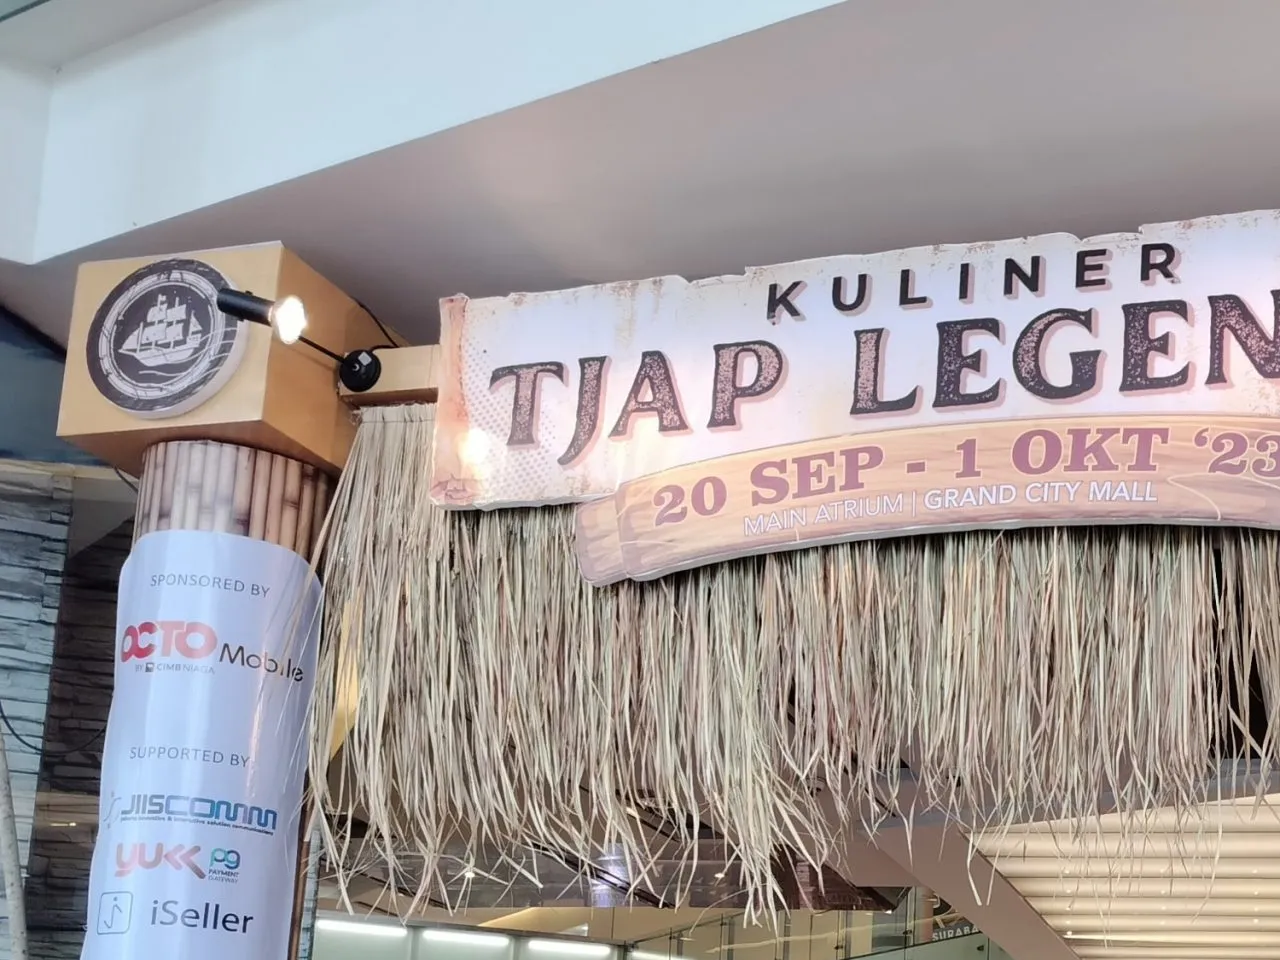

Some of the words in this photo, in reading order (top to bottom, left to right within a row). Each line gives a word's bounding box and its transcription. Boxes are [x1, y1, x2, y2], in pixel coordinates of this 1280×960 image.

[767, 243, 1179, 321] KULINER
[489, 340, 785, 466] TJAP
[653, 475, 728, 527] 20
[749, 445, 884, 507] SEP
[954, 438, 981, 479] 1
[1011, 427, 1170, 476] OKT
[743, 511, 807, 537] MAIN
[814, 493, 903, 523] ATRIUM
[923, 484, 1017, 510] GRAND
[1024, 481, 1080, 503] CITY
[1088, 480, 1158, 502] MALL
[150, 573, 245, 593] SPONSORED
[251, 584, 271, 598] BY
[121, 620, 218, 663] OCTO
[129, 746, 224, 764] SUPPORTED
[230, 753, 251, 768] BY
[150, 899, 254, 934] iSeller
